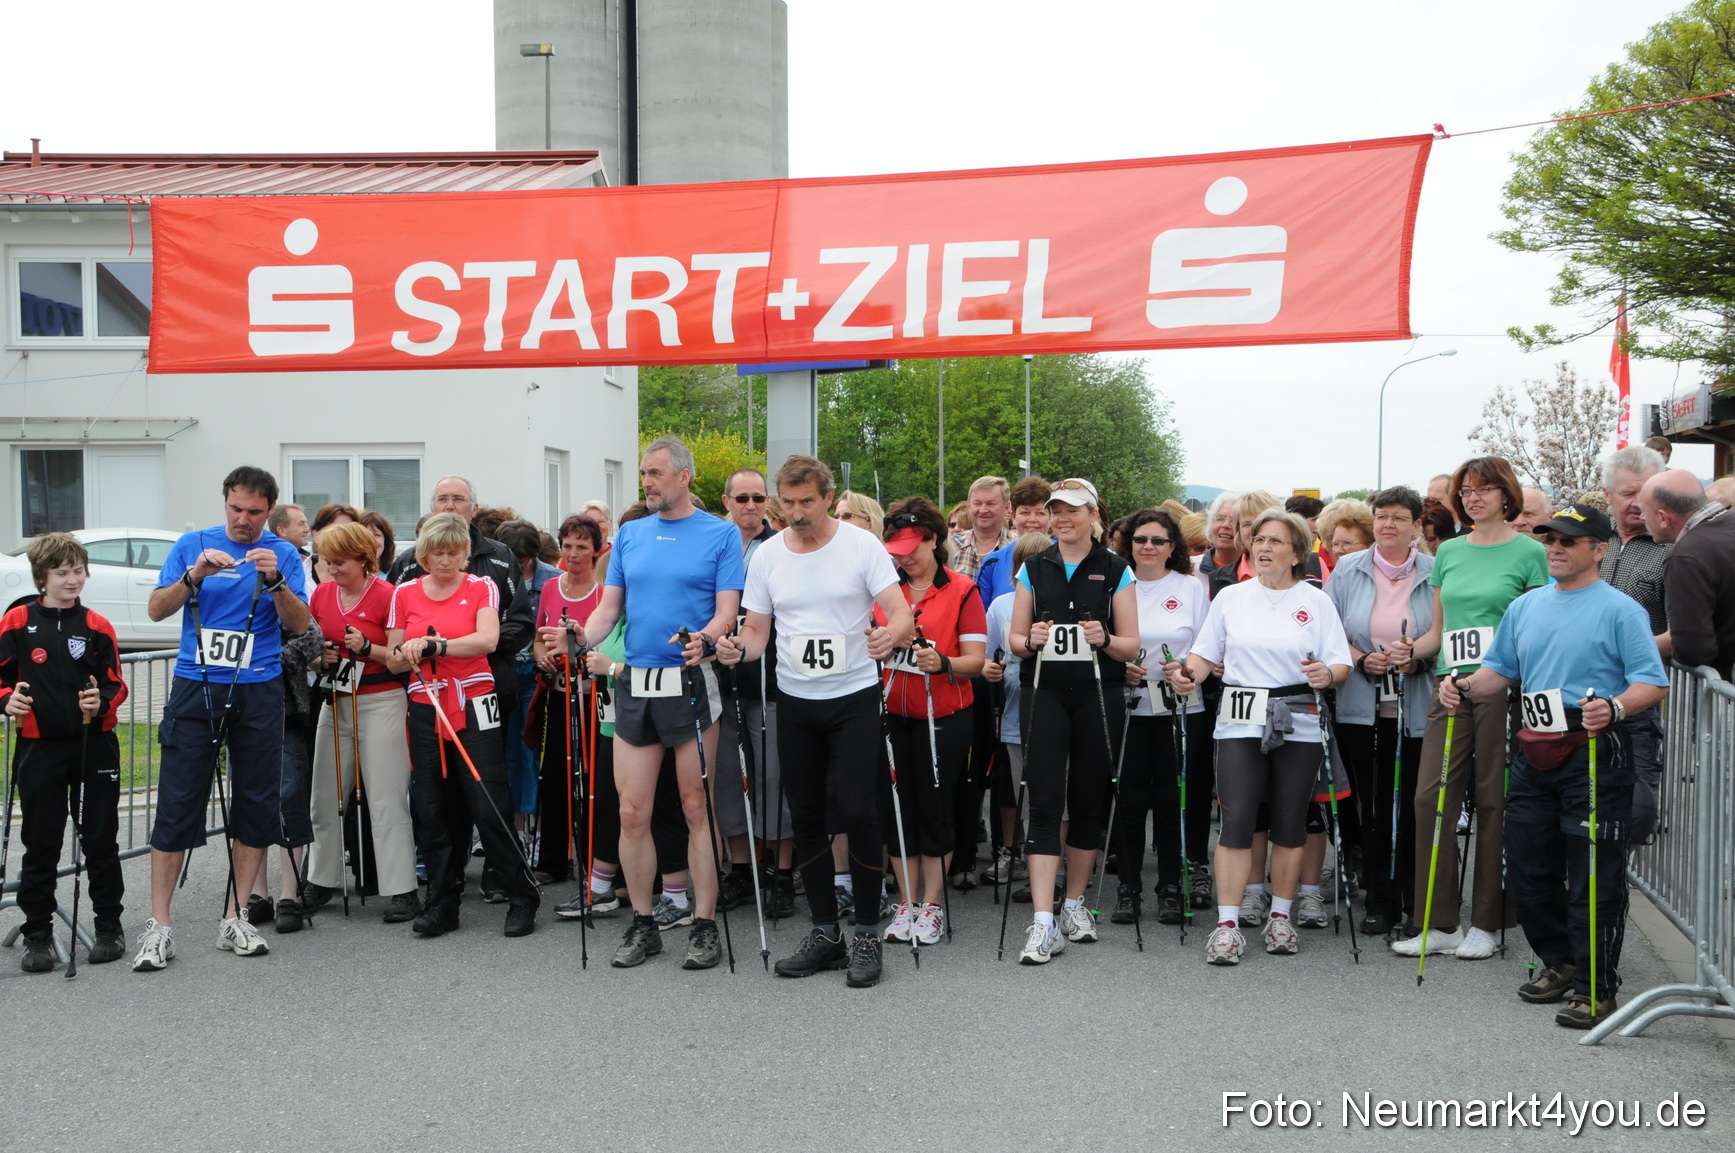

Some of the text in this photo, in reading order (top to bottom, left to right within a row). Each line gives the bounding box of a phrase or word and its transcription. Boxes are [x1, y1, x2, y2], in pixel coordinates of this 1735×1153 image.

[1672, 396, 1696, 418] SEAT
[209, 632, 243, 662] 50
[802, 639, 834, 669] 45
[1054, 626, 1078, 655] 91
[1450, 629, 1481, 661] 119
[1231, 691, 1256, 720] 117
[1523, 693, 1553, 728] 89
